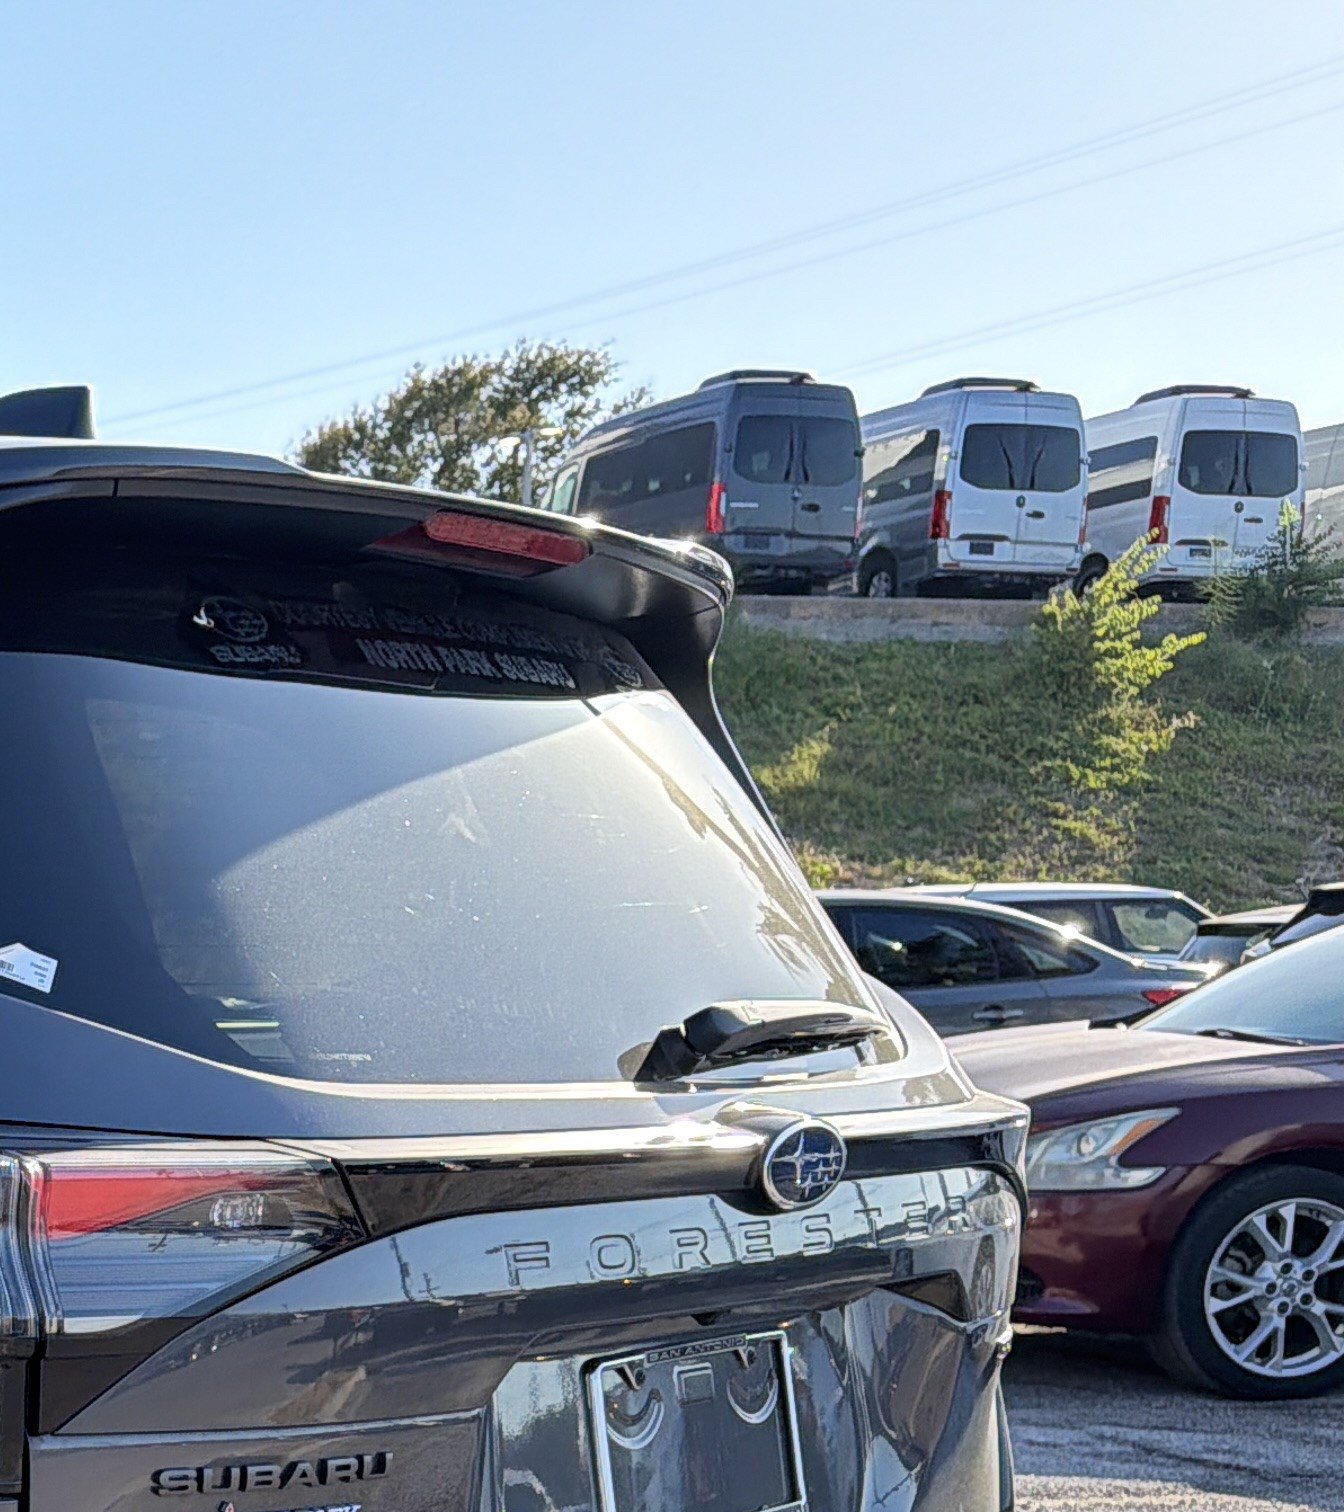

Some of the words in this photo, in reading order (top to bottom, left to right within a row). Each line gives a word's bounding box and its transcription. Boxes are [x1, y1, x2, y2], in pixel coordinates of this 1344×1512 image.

[355, 638, 444, 672] NORTH
[433, 645, 502, 679] PARK
[494, 652, 576, 689] SUBARU
[502, 1195, 971, 1288] FORESTER
[649, 1349, 681, 1362] SAN
[684, 1337, 744, 1356] ANTONIO
[153, 1452, 394, 1496] SUBARU
